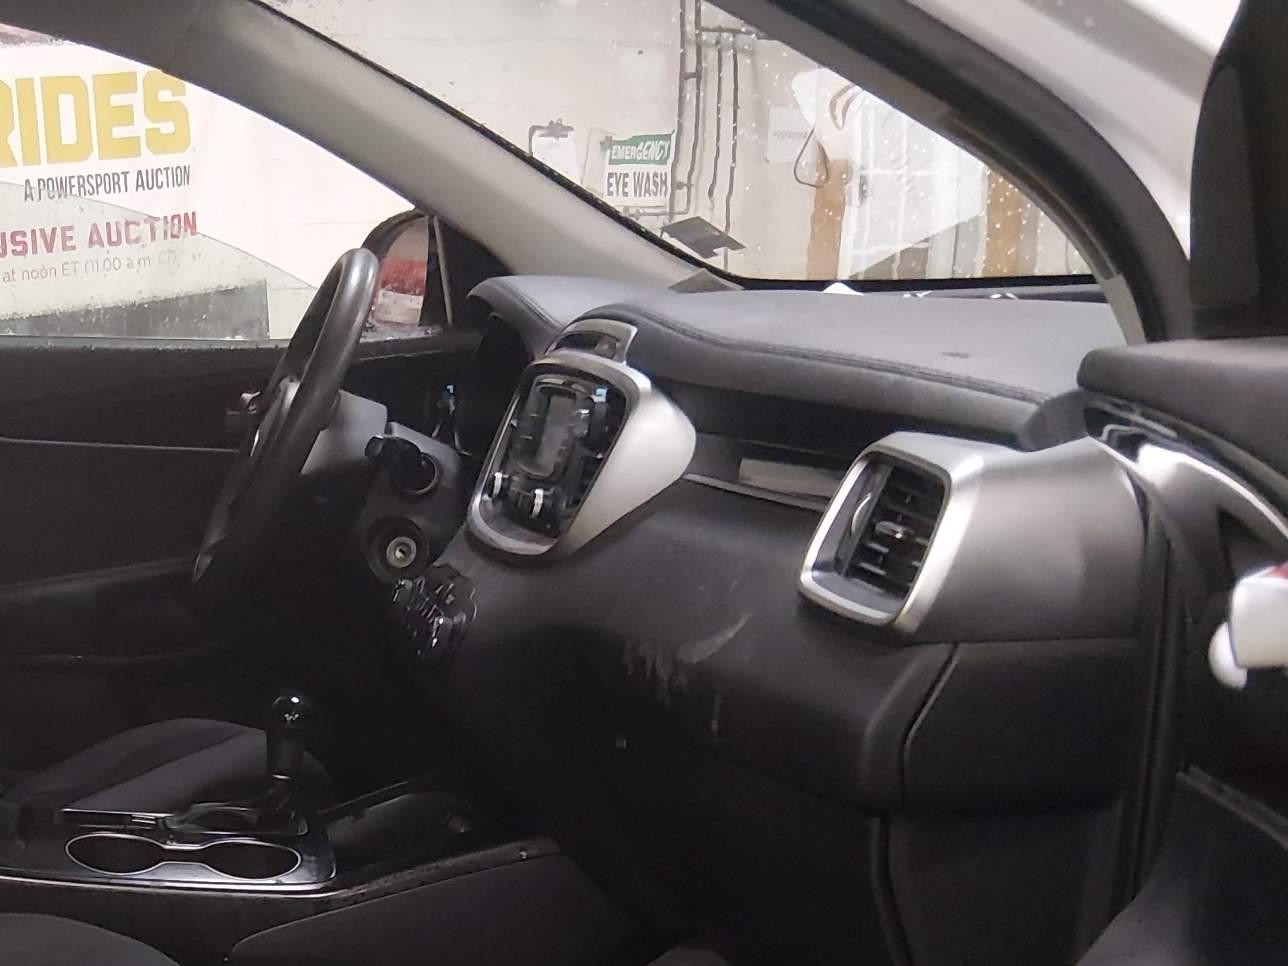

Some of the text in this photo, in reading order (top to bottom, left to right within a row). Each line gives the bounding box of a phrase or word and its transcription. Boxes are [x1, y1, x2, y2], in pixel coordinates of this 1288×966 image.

[611, 139, 670, 161] EMERGENCY
[24, 165, 191, 202] A POWERSPORT AUCTION
[607, 171, 668, 198] EYE WASH
[88, 211, 197, 249] AUCTION
[2, 268, 16, 283] at
[21, 265, 57, 281] noon
[61, 260, 79, 277] ET
